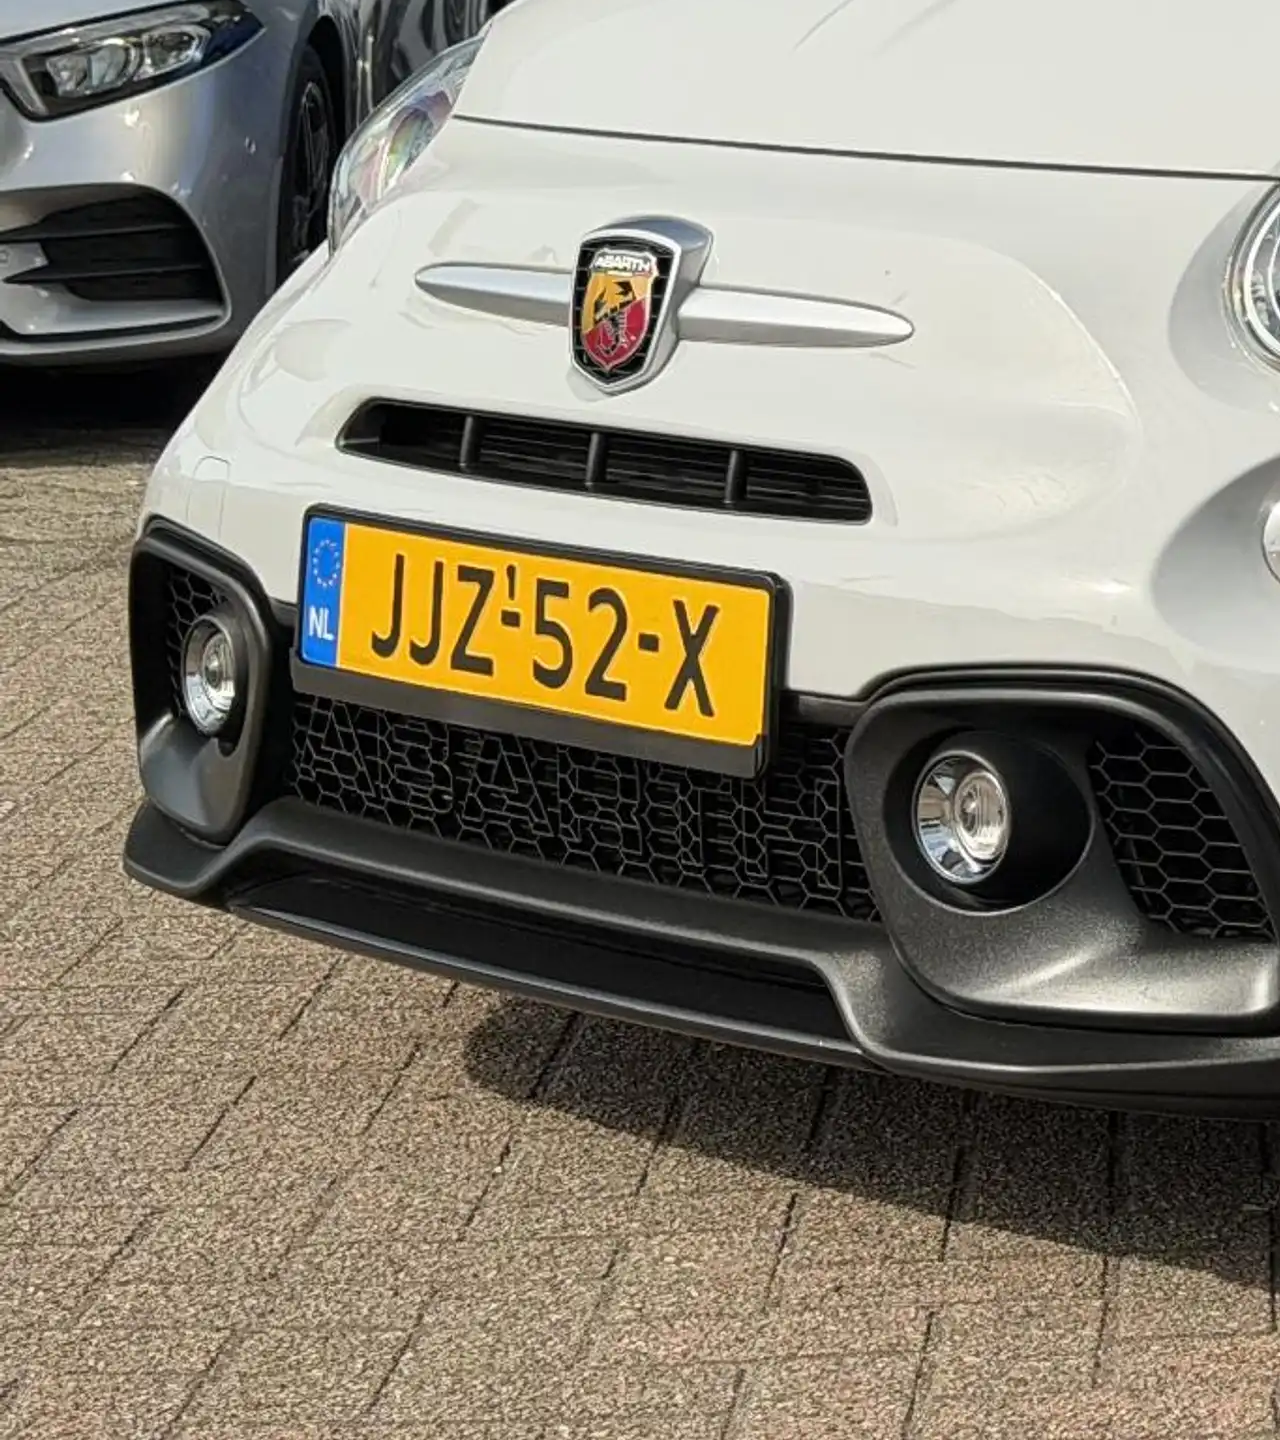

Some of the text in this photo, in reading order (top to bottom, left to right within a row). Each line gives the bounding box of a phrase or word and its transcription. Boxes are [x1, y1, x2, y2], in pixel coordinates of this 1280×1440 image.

[593, 254, 651, 272] ABARTH
[308, 605, 335, 641] NL
[370, 554, 720, 718] JJZ-52-X
